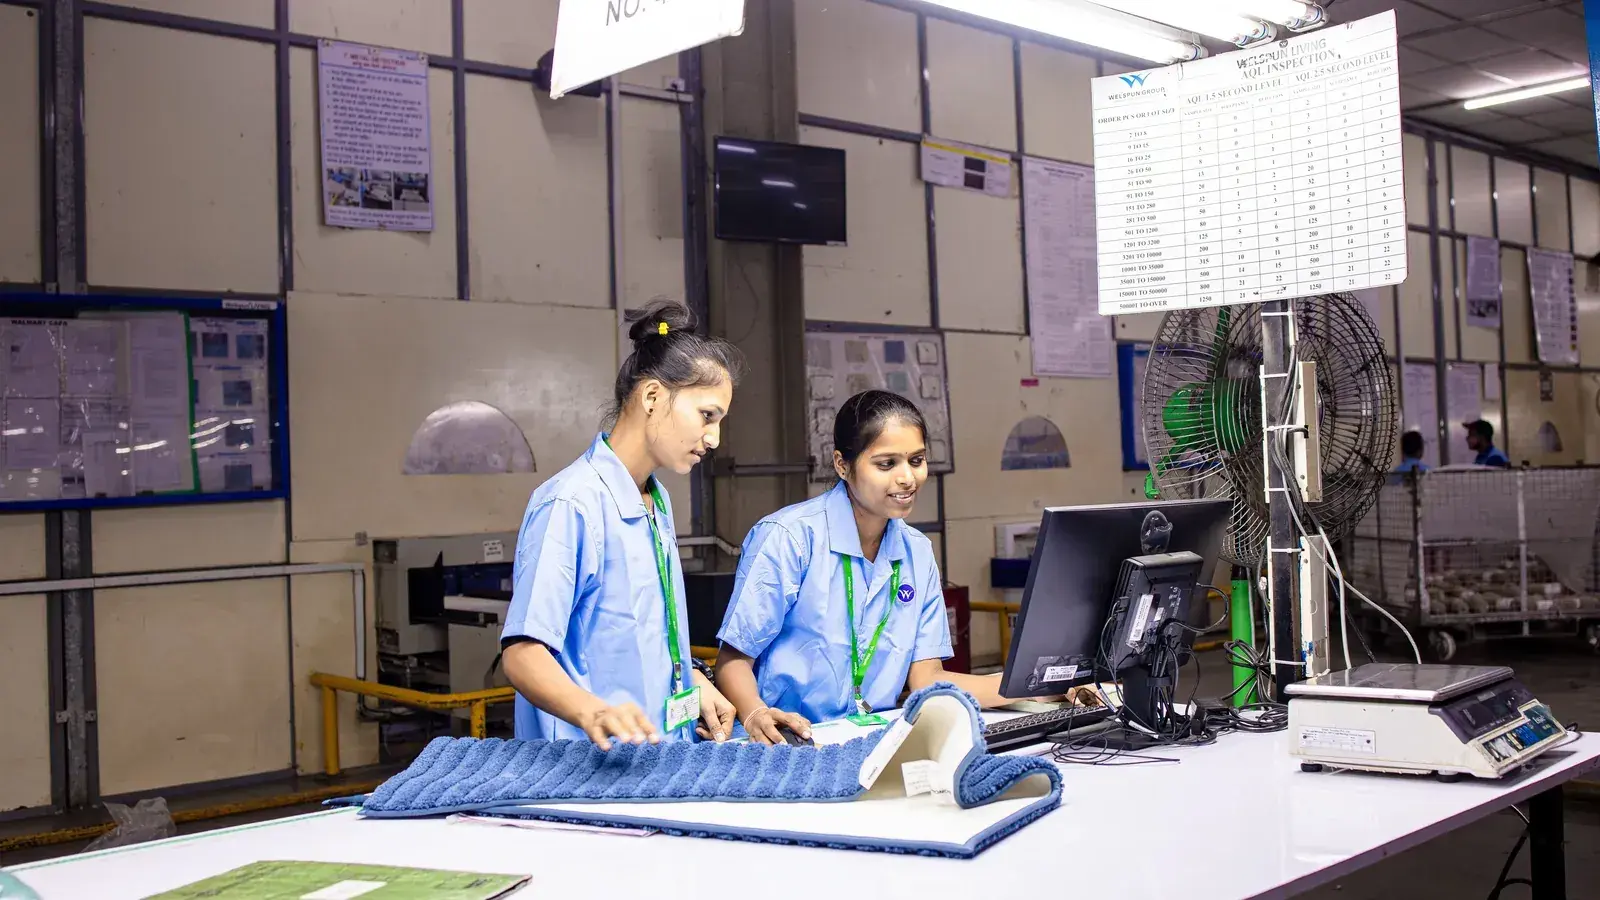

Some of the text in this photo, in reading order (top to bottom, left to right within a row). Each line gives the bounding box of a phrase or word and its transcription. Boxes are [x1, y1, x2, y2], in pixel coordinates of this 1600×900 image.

[1292, 38, 1326, 56] LIVING
[1241, 49, 1336, 80] AQL INSPECTION
[1295, 72, 1312, 82] AQL
[1326, 59, 1361, 73] SECOND
[1363, 50, 1391, 65] LEVEL
[1108, 87, 1166, 101] WELSPUN GROUP
[1187, 94, 1204, 105] AQL
[1218, 85, 1253, 98] SECOND
[1255, 78, 1283, 91] LEVEL
